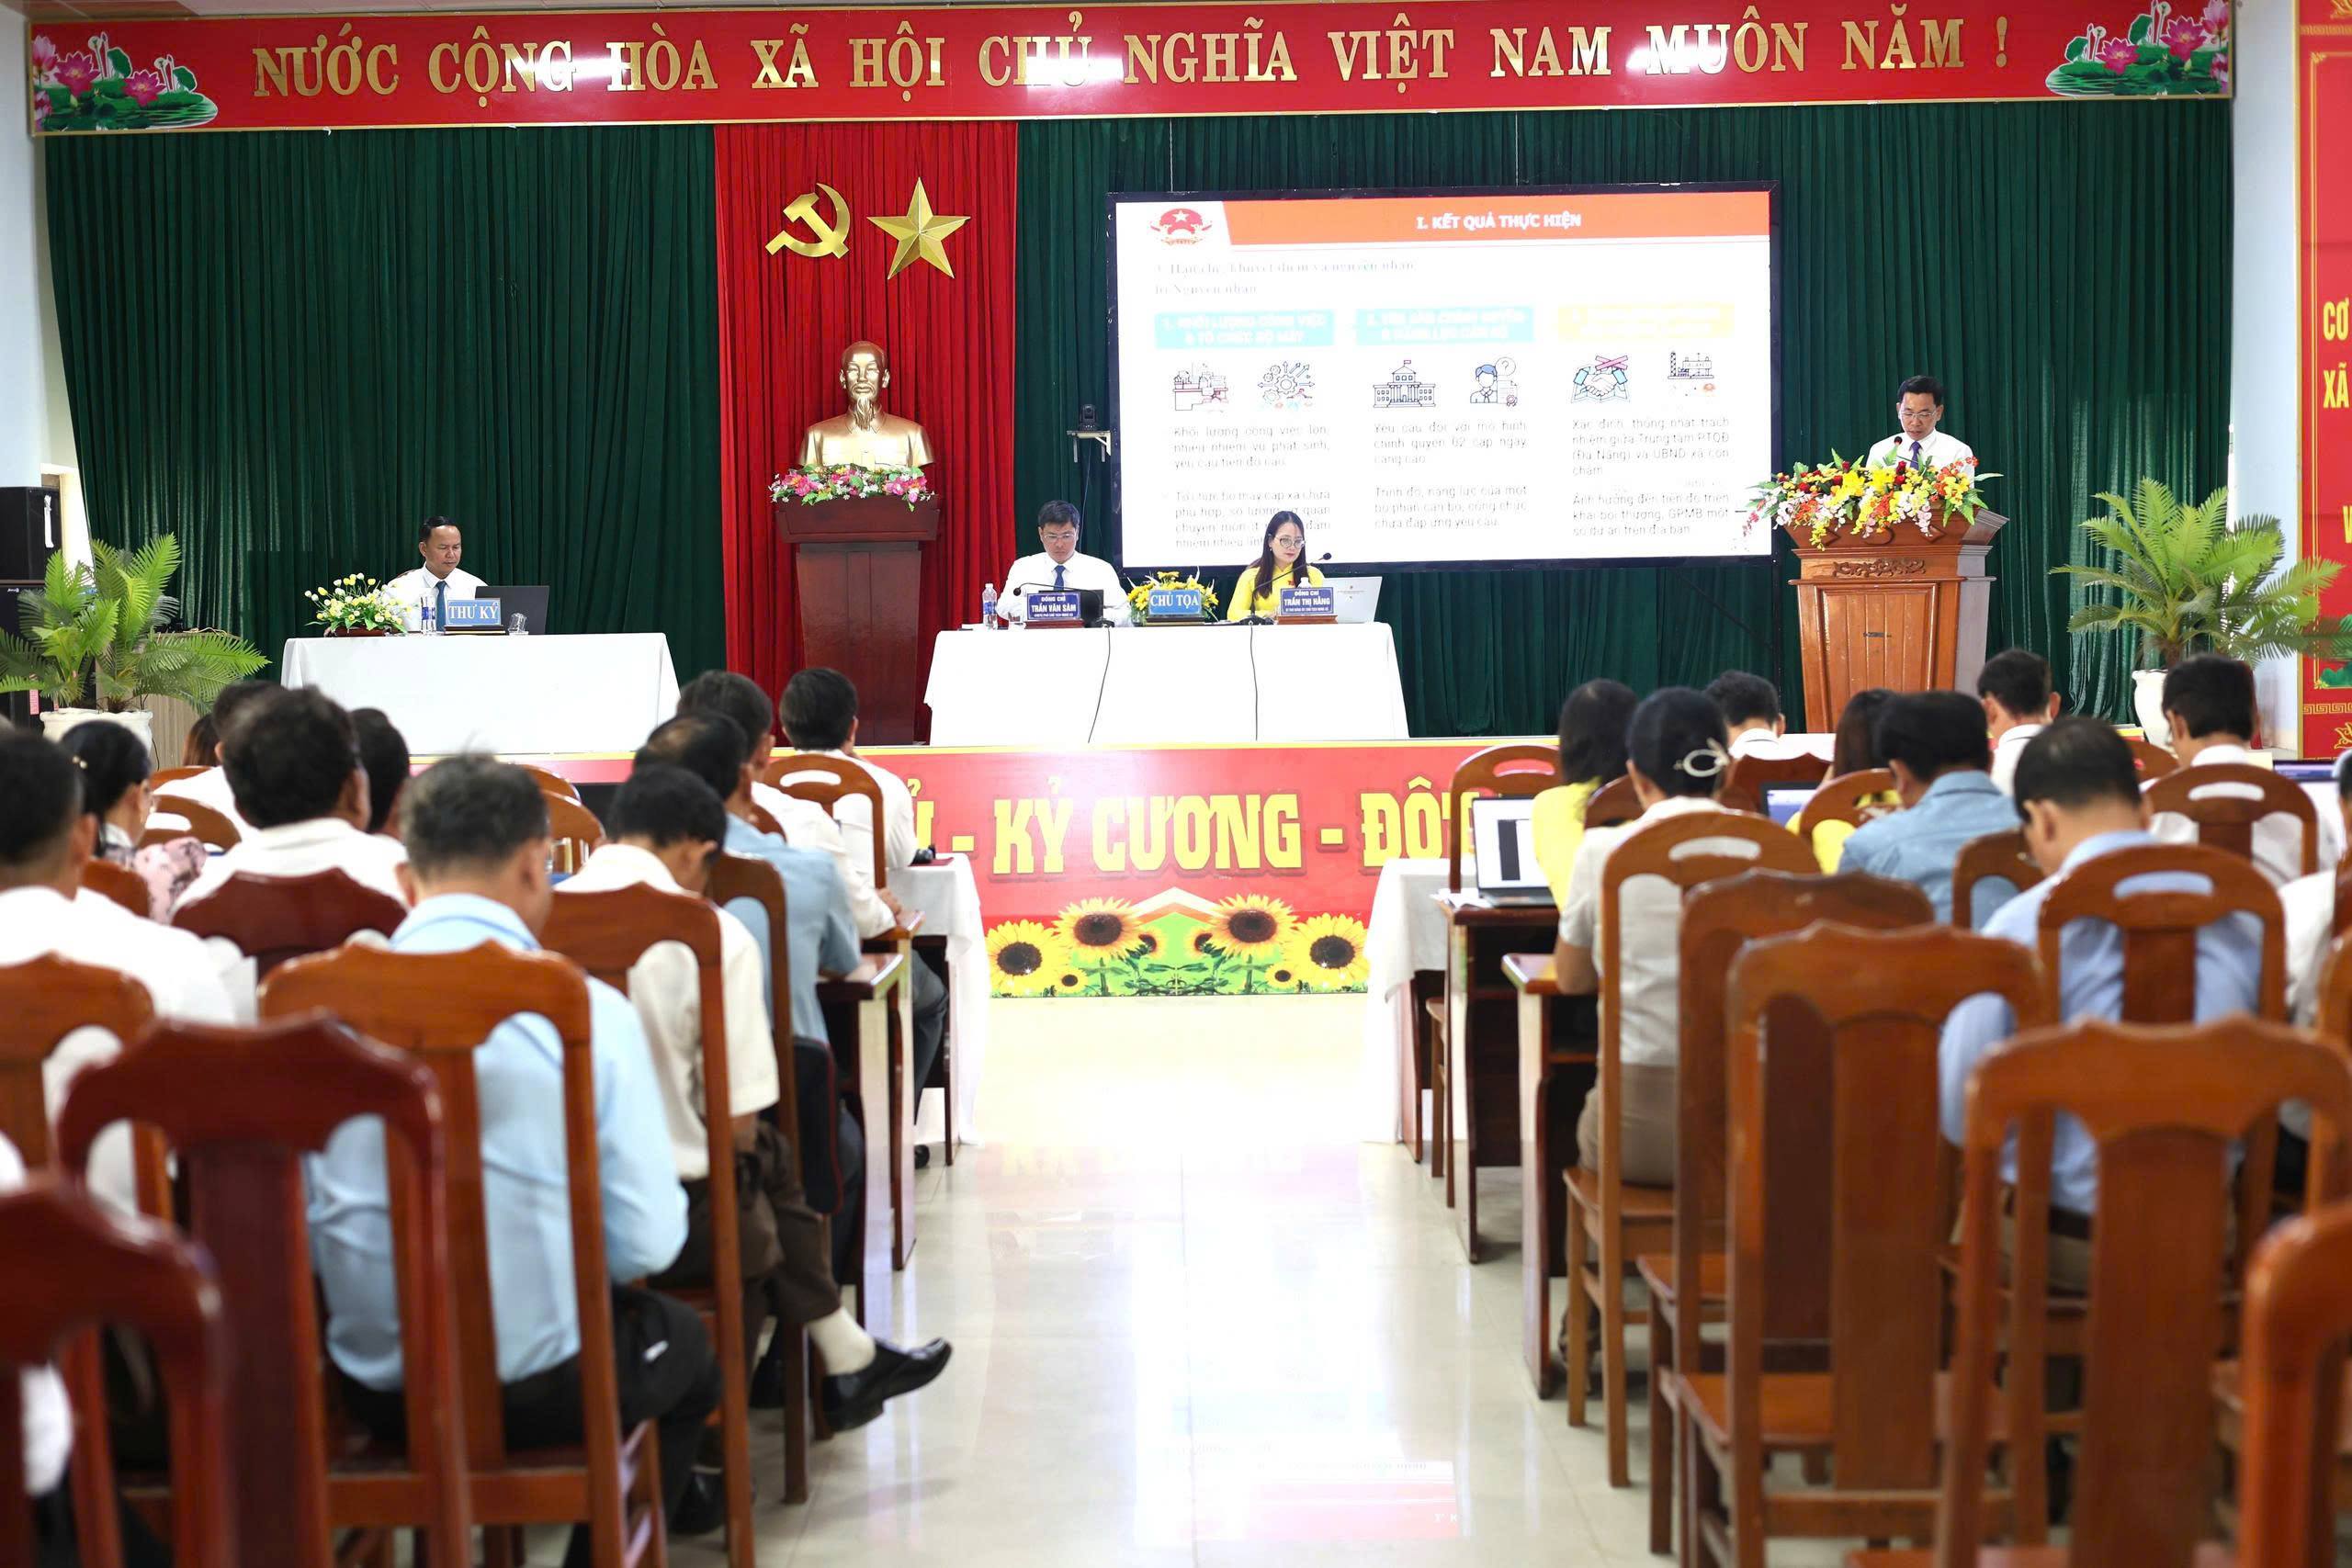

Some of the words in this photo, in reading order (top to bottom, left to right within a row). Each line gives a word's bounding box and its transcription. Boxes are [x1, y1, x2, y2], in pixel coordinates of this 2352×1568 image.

[253, 22, 399, 97] NƯỚC
[428, 26, 577, 107] CỘNG
[605, 22, 718, 92] HÒA
[750, 23, 820, 89] XÃ
[848, 20, 945, 102] HỘI
[978, 11, 1092, 87] CHỦ
[1124, 17, 1297, 85] NGHĨA
[1327, 13, 1454, 95] VIỆT
[1489, 25, 1612, 78] NAM
[1645, 5, 1809, 76] MUÔN
[1840, 3, 1964, 70] NĂM
[1995, 16, 2007, 69] !
[1431, 213, 1461, 229] KẾT
[1464, 211, 1496, 231] QUẢ
[1498, 212, 1541, 230] THỰC
[1544, 210, 1581, 229] HIỆN
[2323, 297, 2349, 342] CƠ
[2323, 362, 2349, 409] XÃ
[448, 604, 477, 619] THƯ
[1150, 592, 1173, 606] CHỦ
[992, 775, 1072, 875] KỶ
[1091, 793, 1303, 872] CƯƠNG
